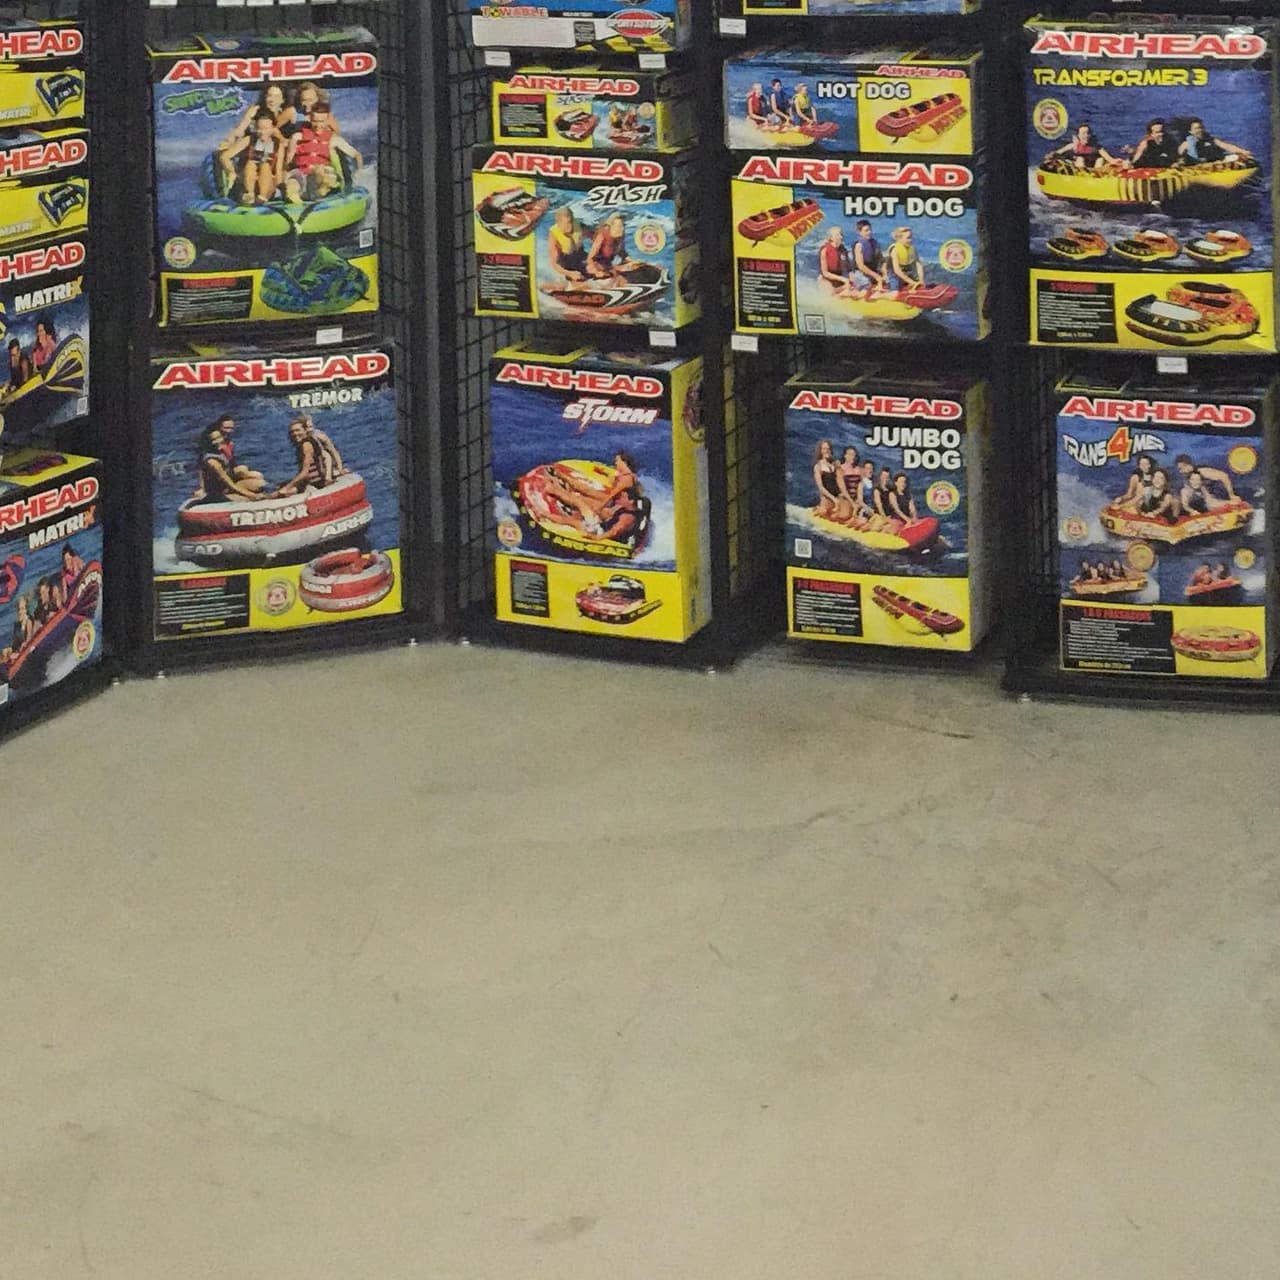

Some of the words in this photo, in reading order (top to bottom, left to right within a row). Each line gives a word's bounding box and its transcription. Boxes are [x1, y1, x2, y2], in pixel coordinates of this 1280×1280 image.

[1030, 31, 1267, 58] AIRHEAD
[161, 53, 376, 84] AIRHEAD
[875, 65, 966, 78] AIRHEAD
[1033, 69, 1187, 86] TRANSFORMER
[1189, 69, 1208, 86] 3
[509, 75, 639, 94] AIRHEAD
[818, 83, 860, 98] HOT
[867, 83, 911, 99] DOG
[484, 152, 663, 181] AIRHEAD
[737, 156, 973, 190] AIRHEAD
[588, 184, 667, 206] SLASH
[845, 196, 899, 216] HOT
[907, 197, 964, 217] DOG
[14, 276, 84, 314] MATRIX
[153, 352, 390, 389] AIRHEAD
[496, 362, 664, 398] AIRHEAD
[289, 388, 362, 409] TREMOR
[789, 390, 962, 418] AIRHEAD
[1059, 396, 1256, 428] AIRHEAD
[866, 427, 960, 448] JUMBO
[904, 450, 961, 469] DOG
[230, 504, 308, 526] TREMOR
[28, 504, 96, 551] MATRIX
